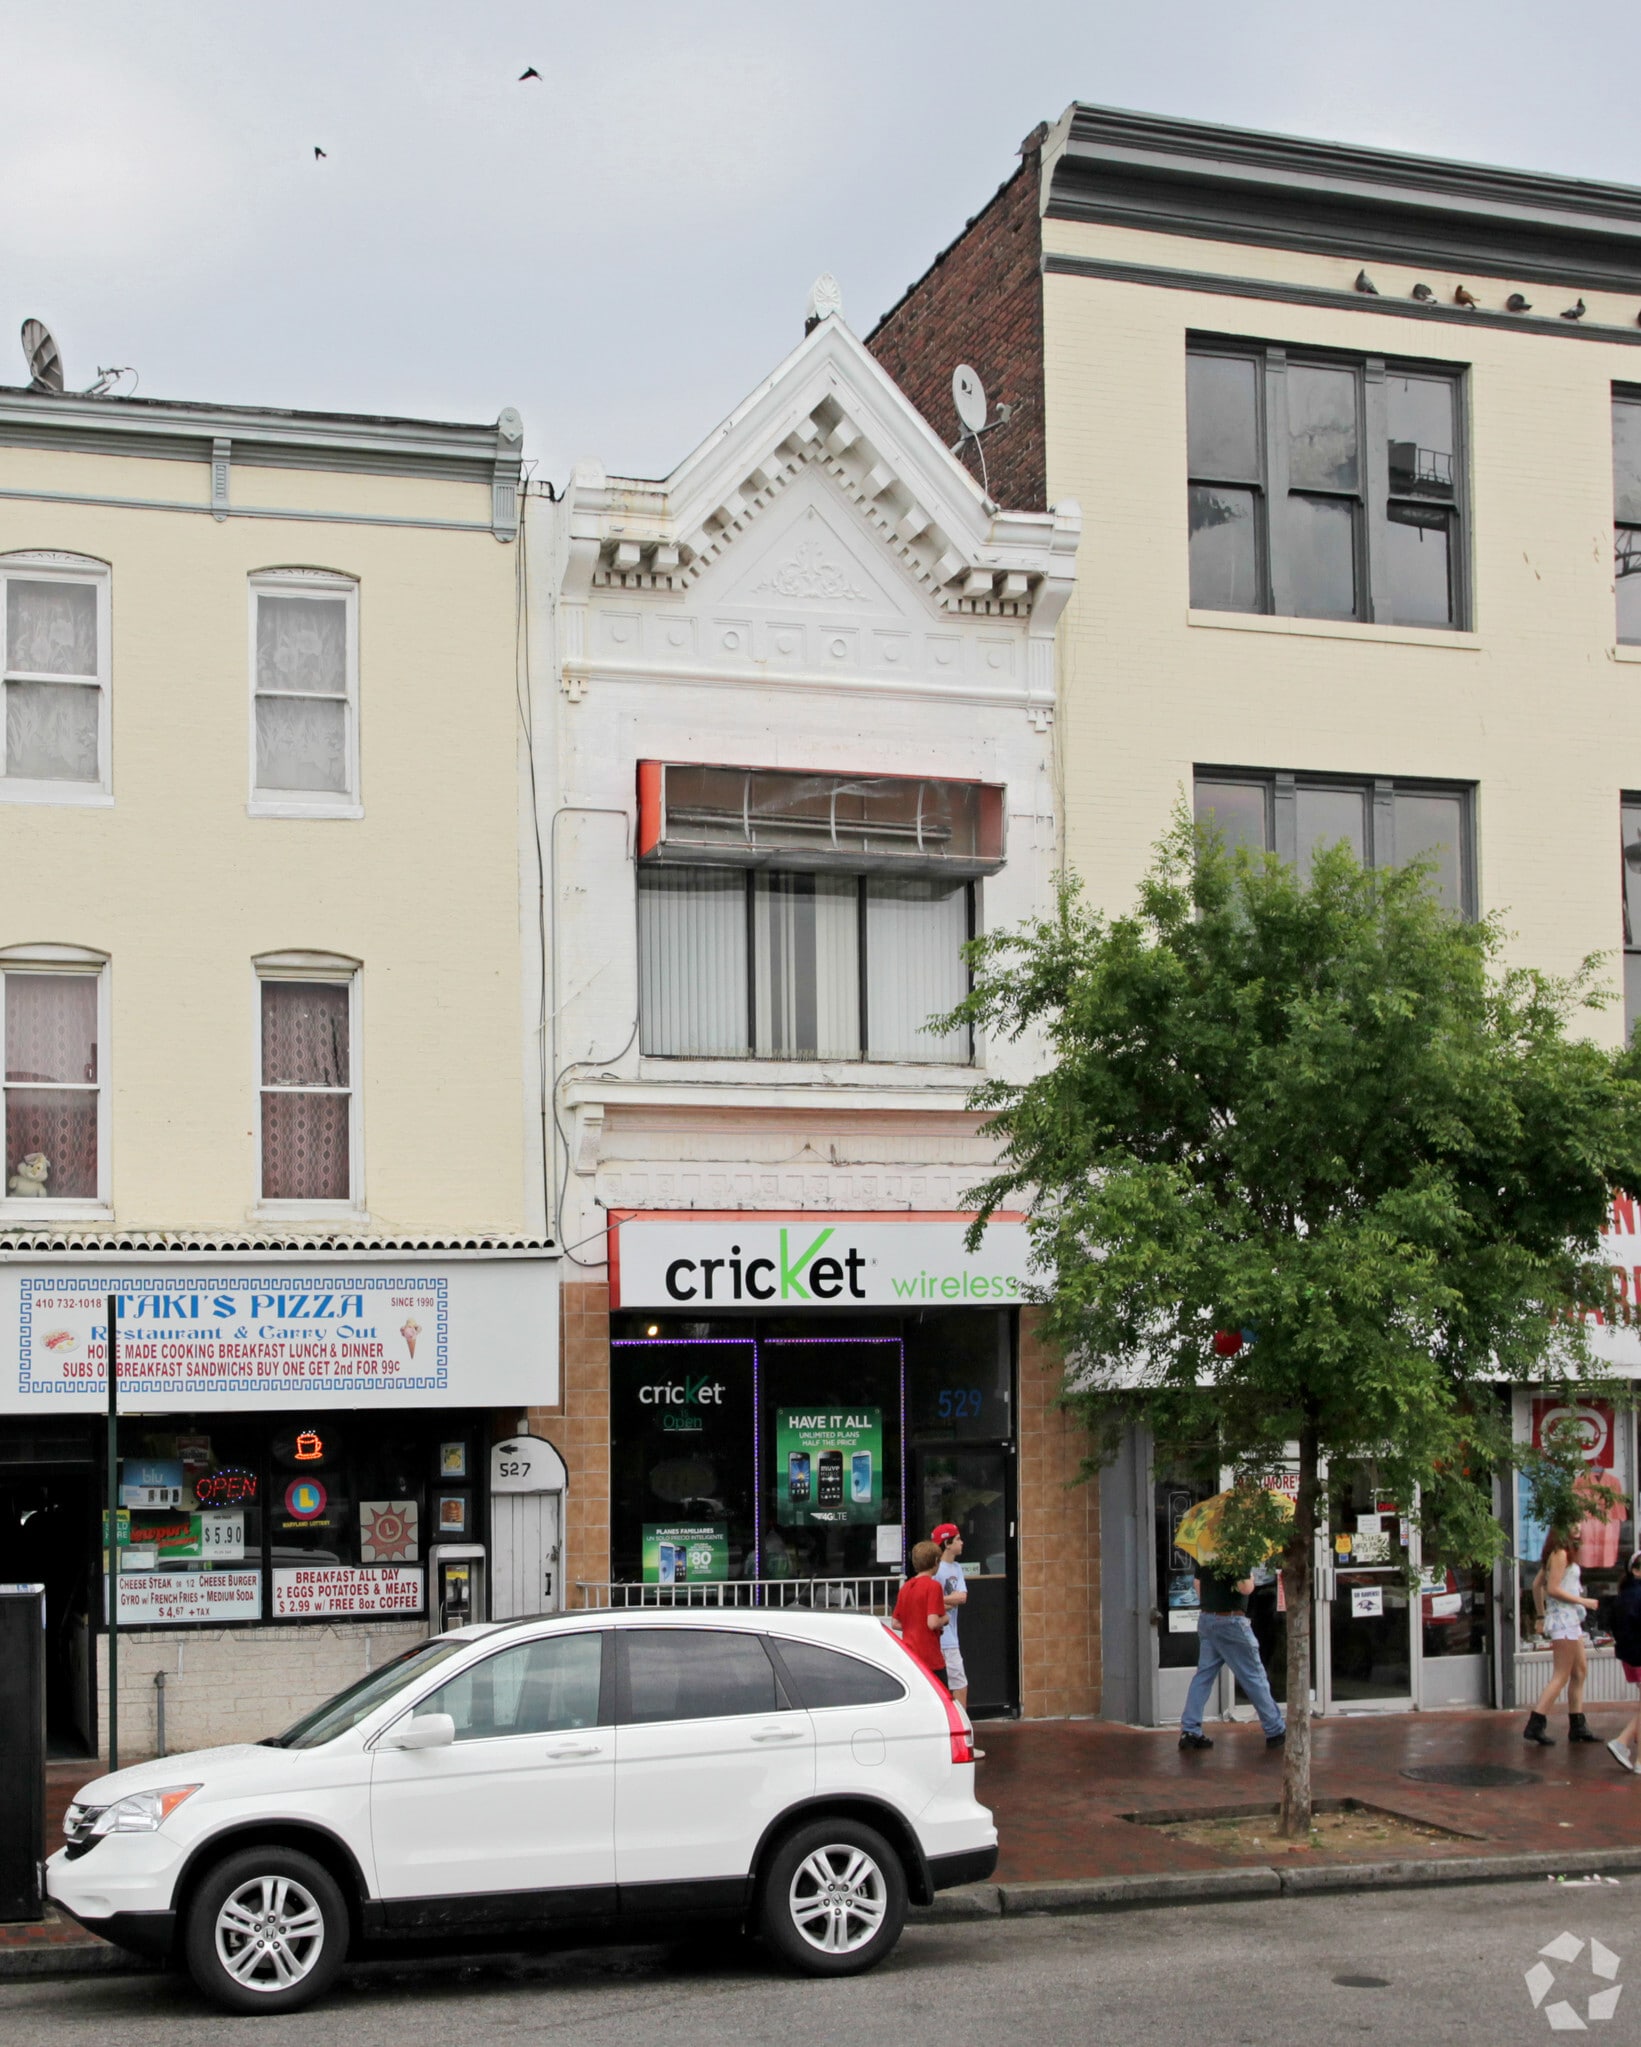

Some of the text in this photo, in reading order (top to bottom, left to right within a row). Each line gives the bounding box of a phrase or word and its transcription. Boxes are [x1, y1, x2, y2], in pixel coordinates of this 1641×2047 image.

[891, 1270, 1019, 1299] wireless
[35, 1298, 102, 1309] 410 732-1018
[116, 1294, 363, 1319] TAKI'S PIZZA
[391, 1297, 434, 1307] SINCE 1990
[233, 1325, 248, 1340] &
[258, 1325, 327, 1342] Carry
[336, 1325, 378, 1340] Out
[87, 1343, 384, 1360] HOE MADE COOKING BREAKFAST LUNCH & DINNER
[62, 1362, 93, 1378] SUBS
[116, 1361, 183, 1377] BREAKFAST
[186, 1361, 253, 1377] SANDWICHS
[257, 1361, 280, 1376] BUY
[282, 1361, 305, 1376] ONE
[308, 1360, 330, 1376] GET
[334, 1360, 353, 1375] 2nd
[357, 1360, 378, 1375] FOR
[938, 1389, 983, 1418] 529
[663, 1414, 703, 1432] Open
[788, 1415, 872, 1429] HAVE IT ALL
[799, 1431, 836, 1439] UNLIMITED
[802, 1439, 820, 1447] HALF
[141, 1467, 165, 1484] blu
[499, 1462, 531, 1478] 527
[196, 1476, 258, 1499] OPEN
[300, 1488, 314, 1508] L
[119, 1578, 147, 1590] CHEESE
[149, 1577, 172, 1589] STEAK
[199, 1575, 226, 1587] CHEESE
[228, 1574, 257, 1586] BURGER
[296, 1568, 400, 1584] BREAKFAST ALL DAY
[121, 1593, 140, 1606] GYRO
[150, 1592, 177, 1604] FRENCH
[179, 1591, 199, 1603] FRIES
[206, 1590, 235, 1602] MEDIUM
[236, 1589, 254, 1601] SODA
[276, 1582, 418, 1599] 2 EGGS POTATOES & MEATS
[314, 1600, 325, 1611] w/
[329, 1598, 354, 1610] FREE
[358, 1598, 376, 1610] 8oz
[379, 1595, 418, 1608] COFFEE
